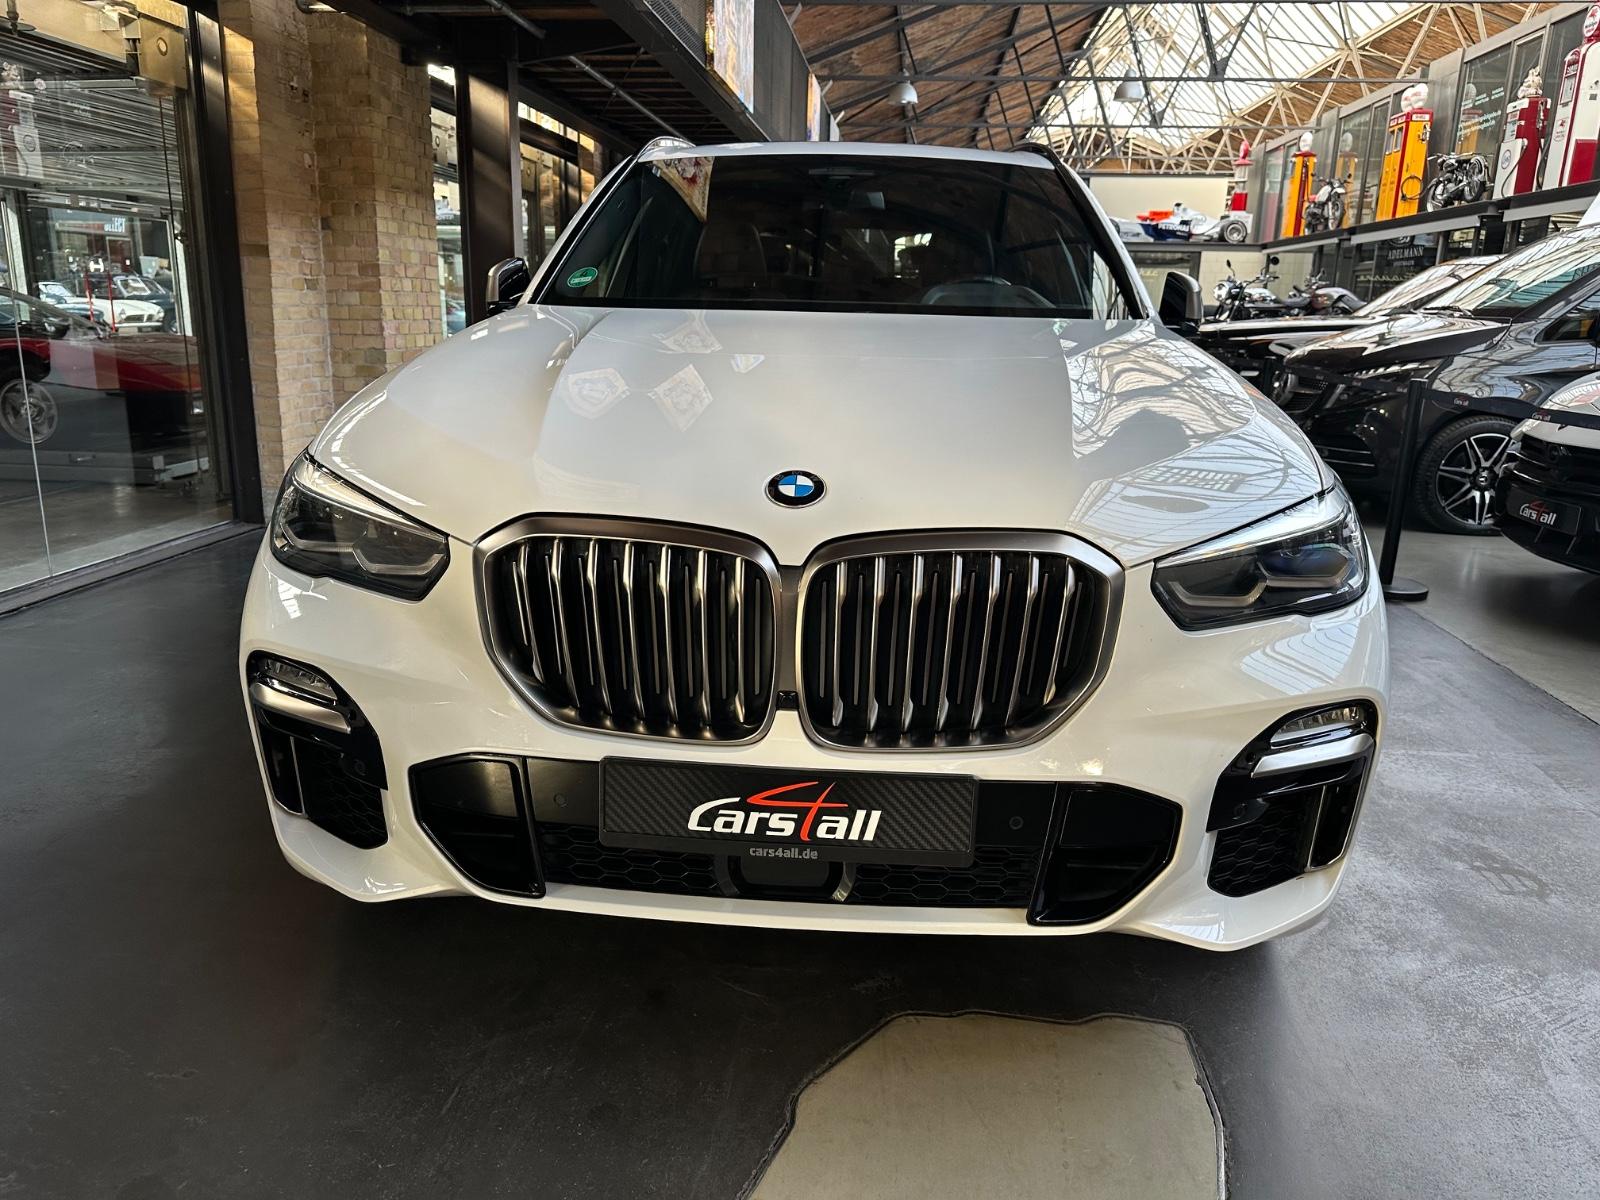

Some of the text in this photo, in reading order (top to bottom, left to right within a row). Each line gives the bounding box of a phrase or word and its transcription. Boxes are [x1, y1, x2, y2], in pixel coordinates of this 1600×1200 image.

[1387, 246, 1424, 260] ADELMANN
[1519, 500, 1557, 526] Cars4all
[687, 781, 882, 842] Cars4all
[749, 846, 818, 860] cars4all.de
